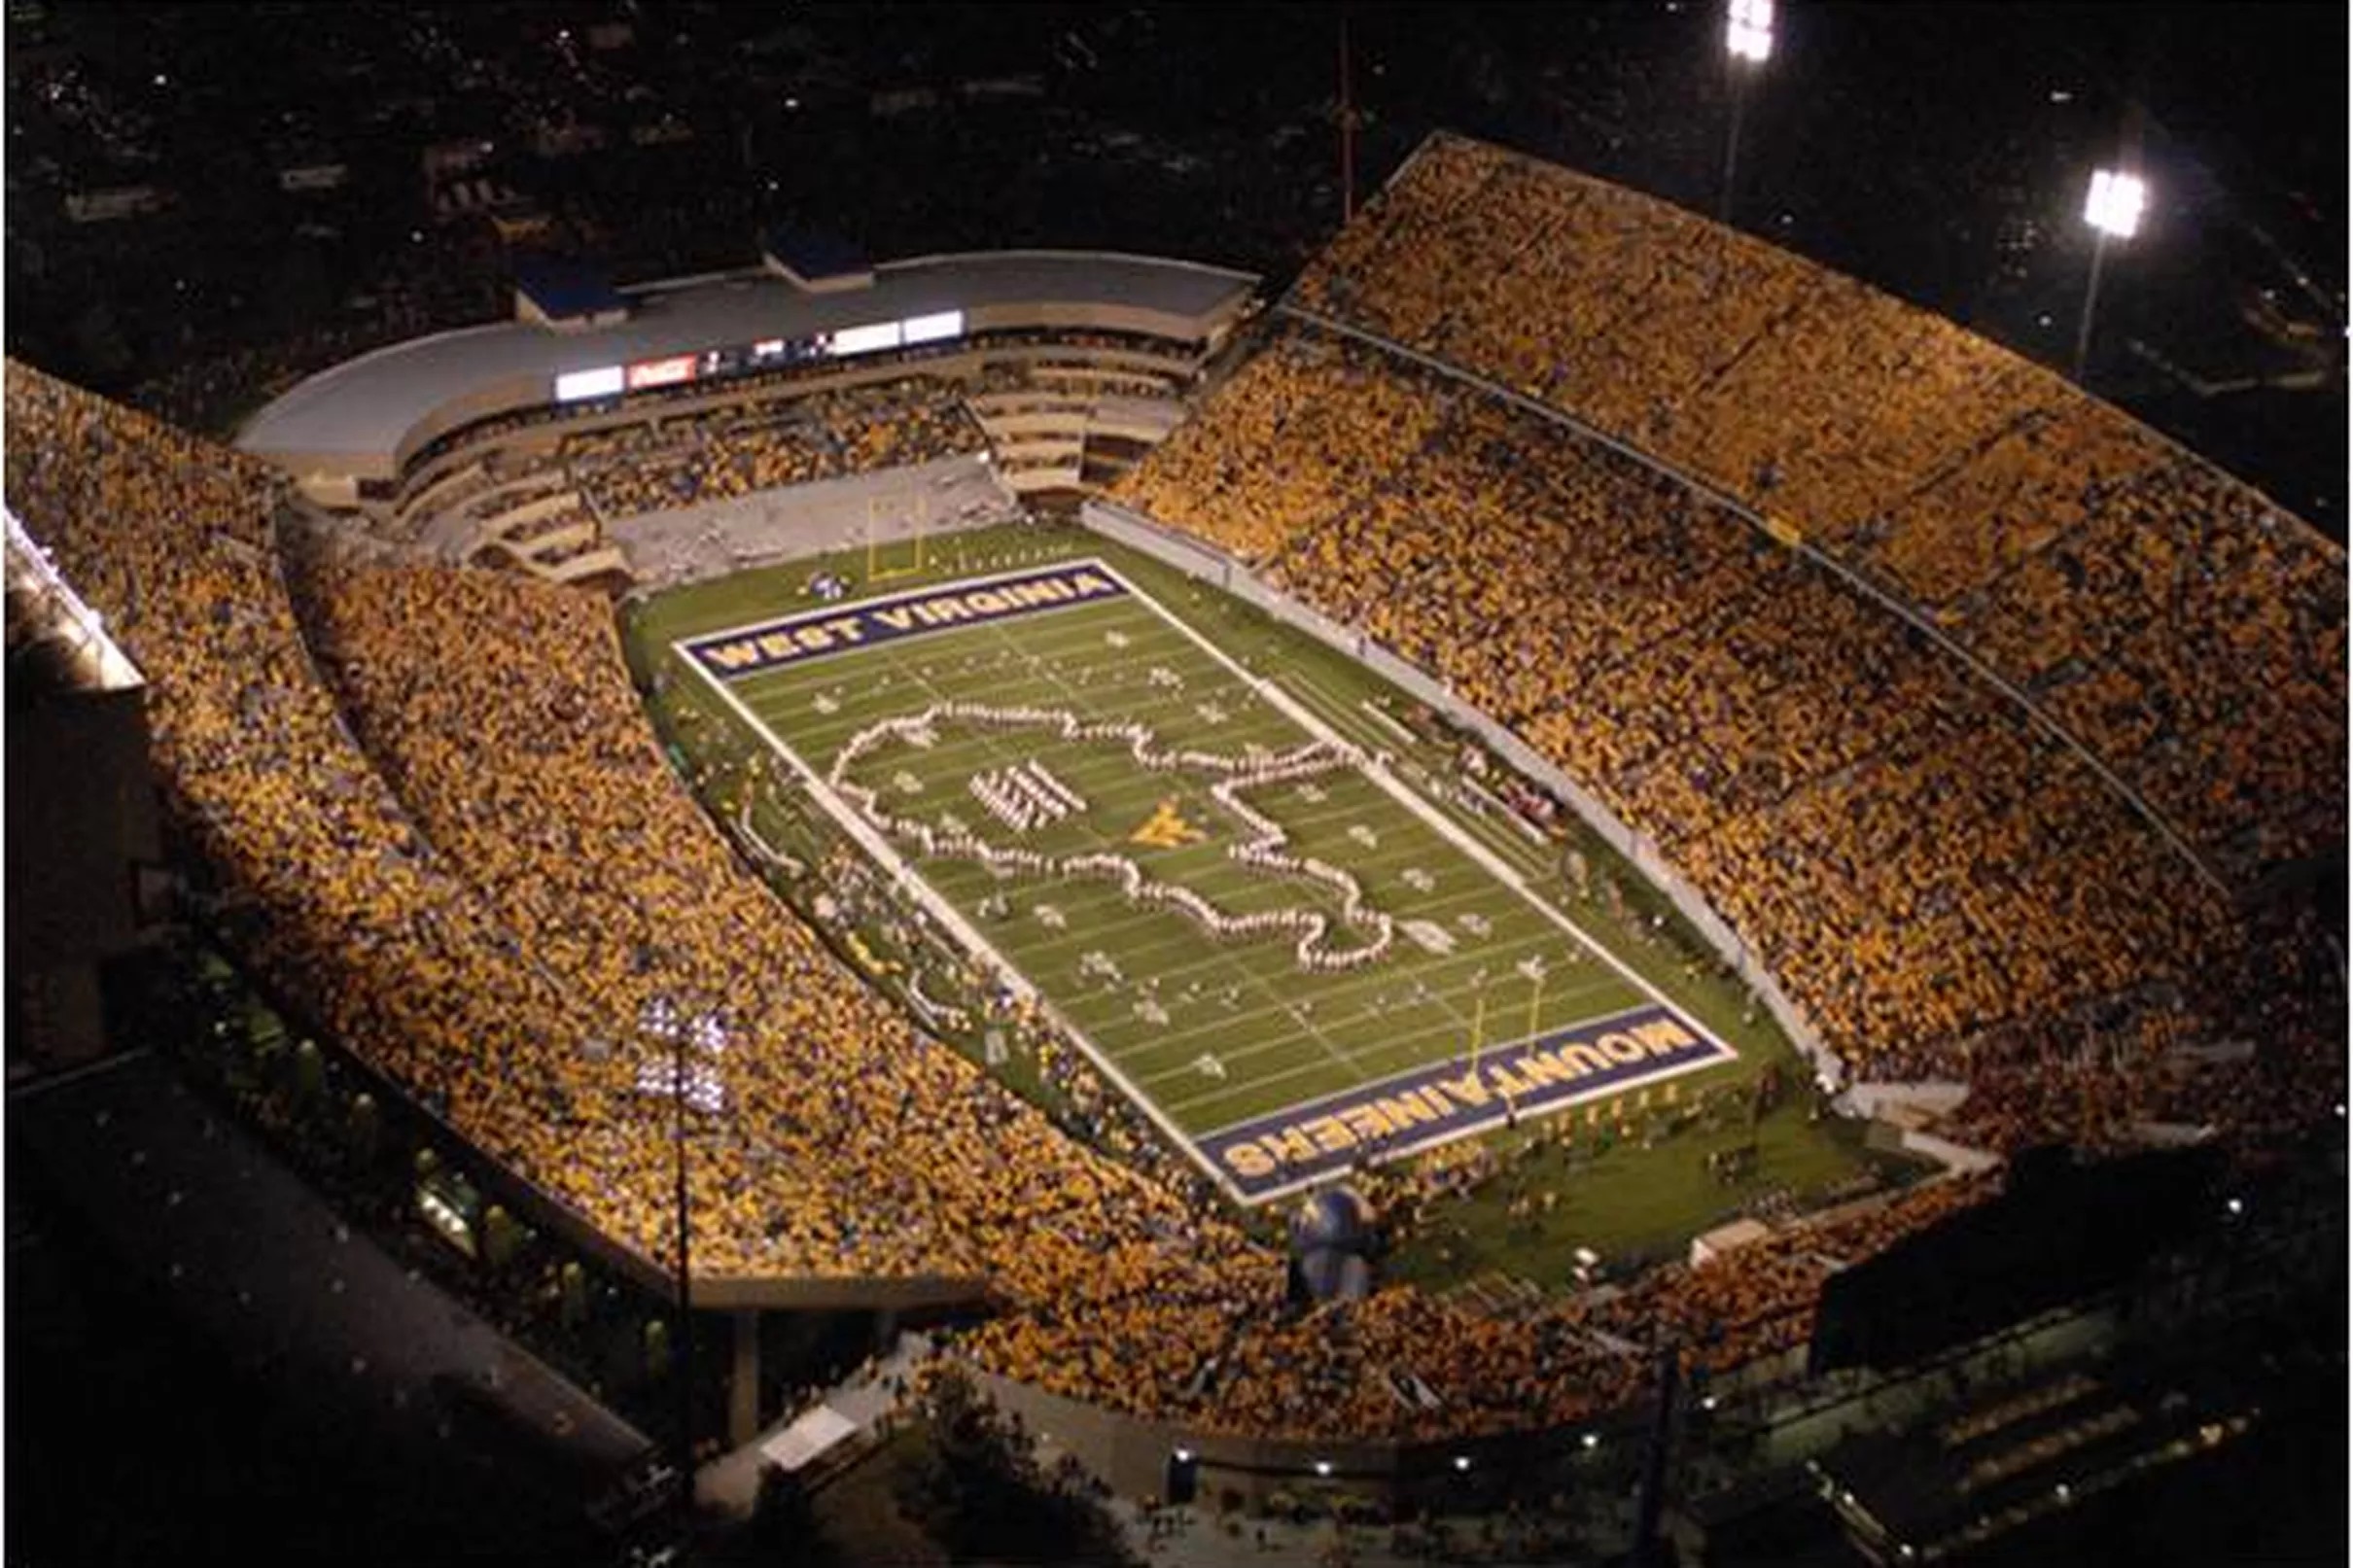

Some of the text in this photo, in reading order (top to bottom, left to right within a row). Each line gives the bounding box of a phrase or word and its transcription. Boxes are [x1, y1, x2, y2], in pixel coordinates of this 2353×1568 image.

[704, 574, 1113, 669] WEST VIRGINIA
[1224, 1018, 1699, 1175] MOUNTAINEERS
